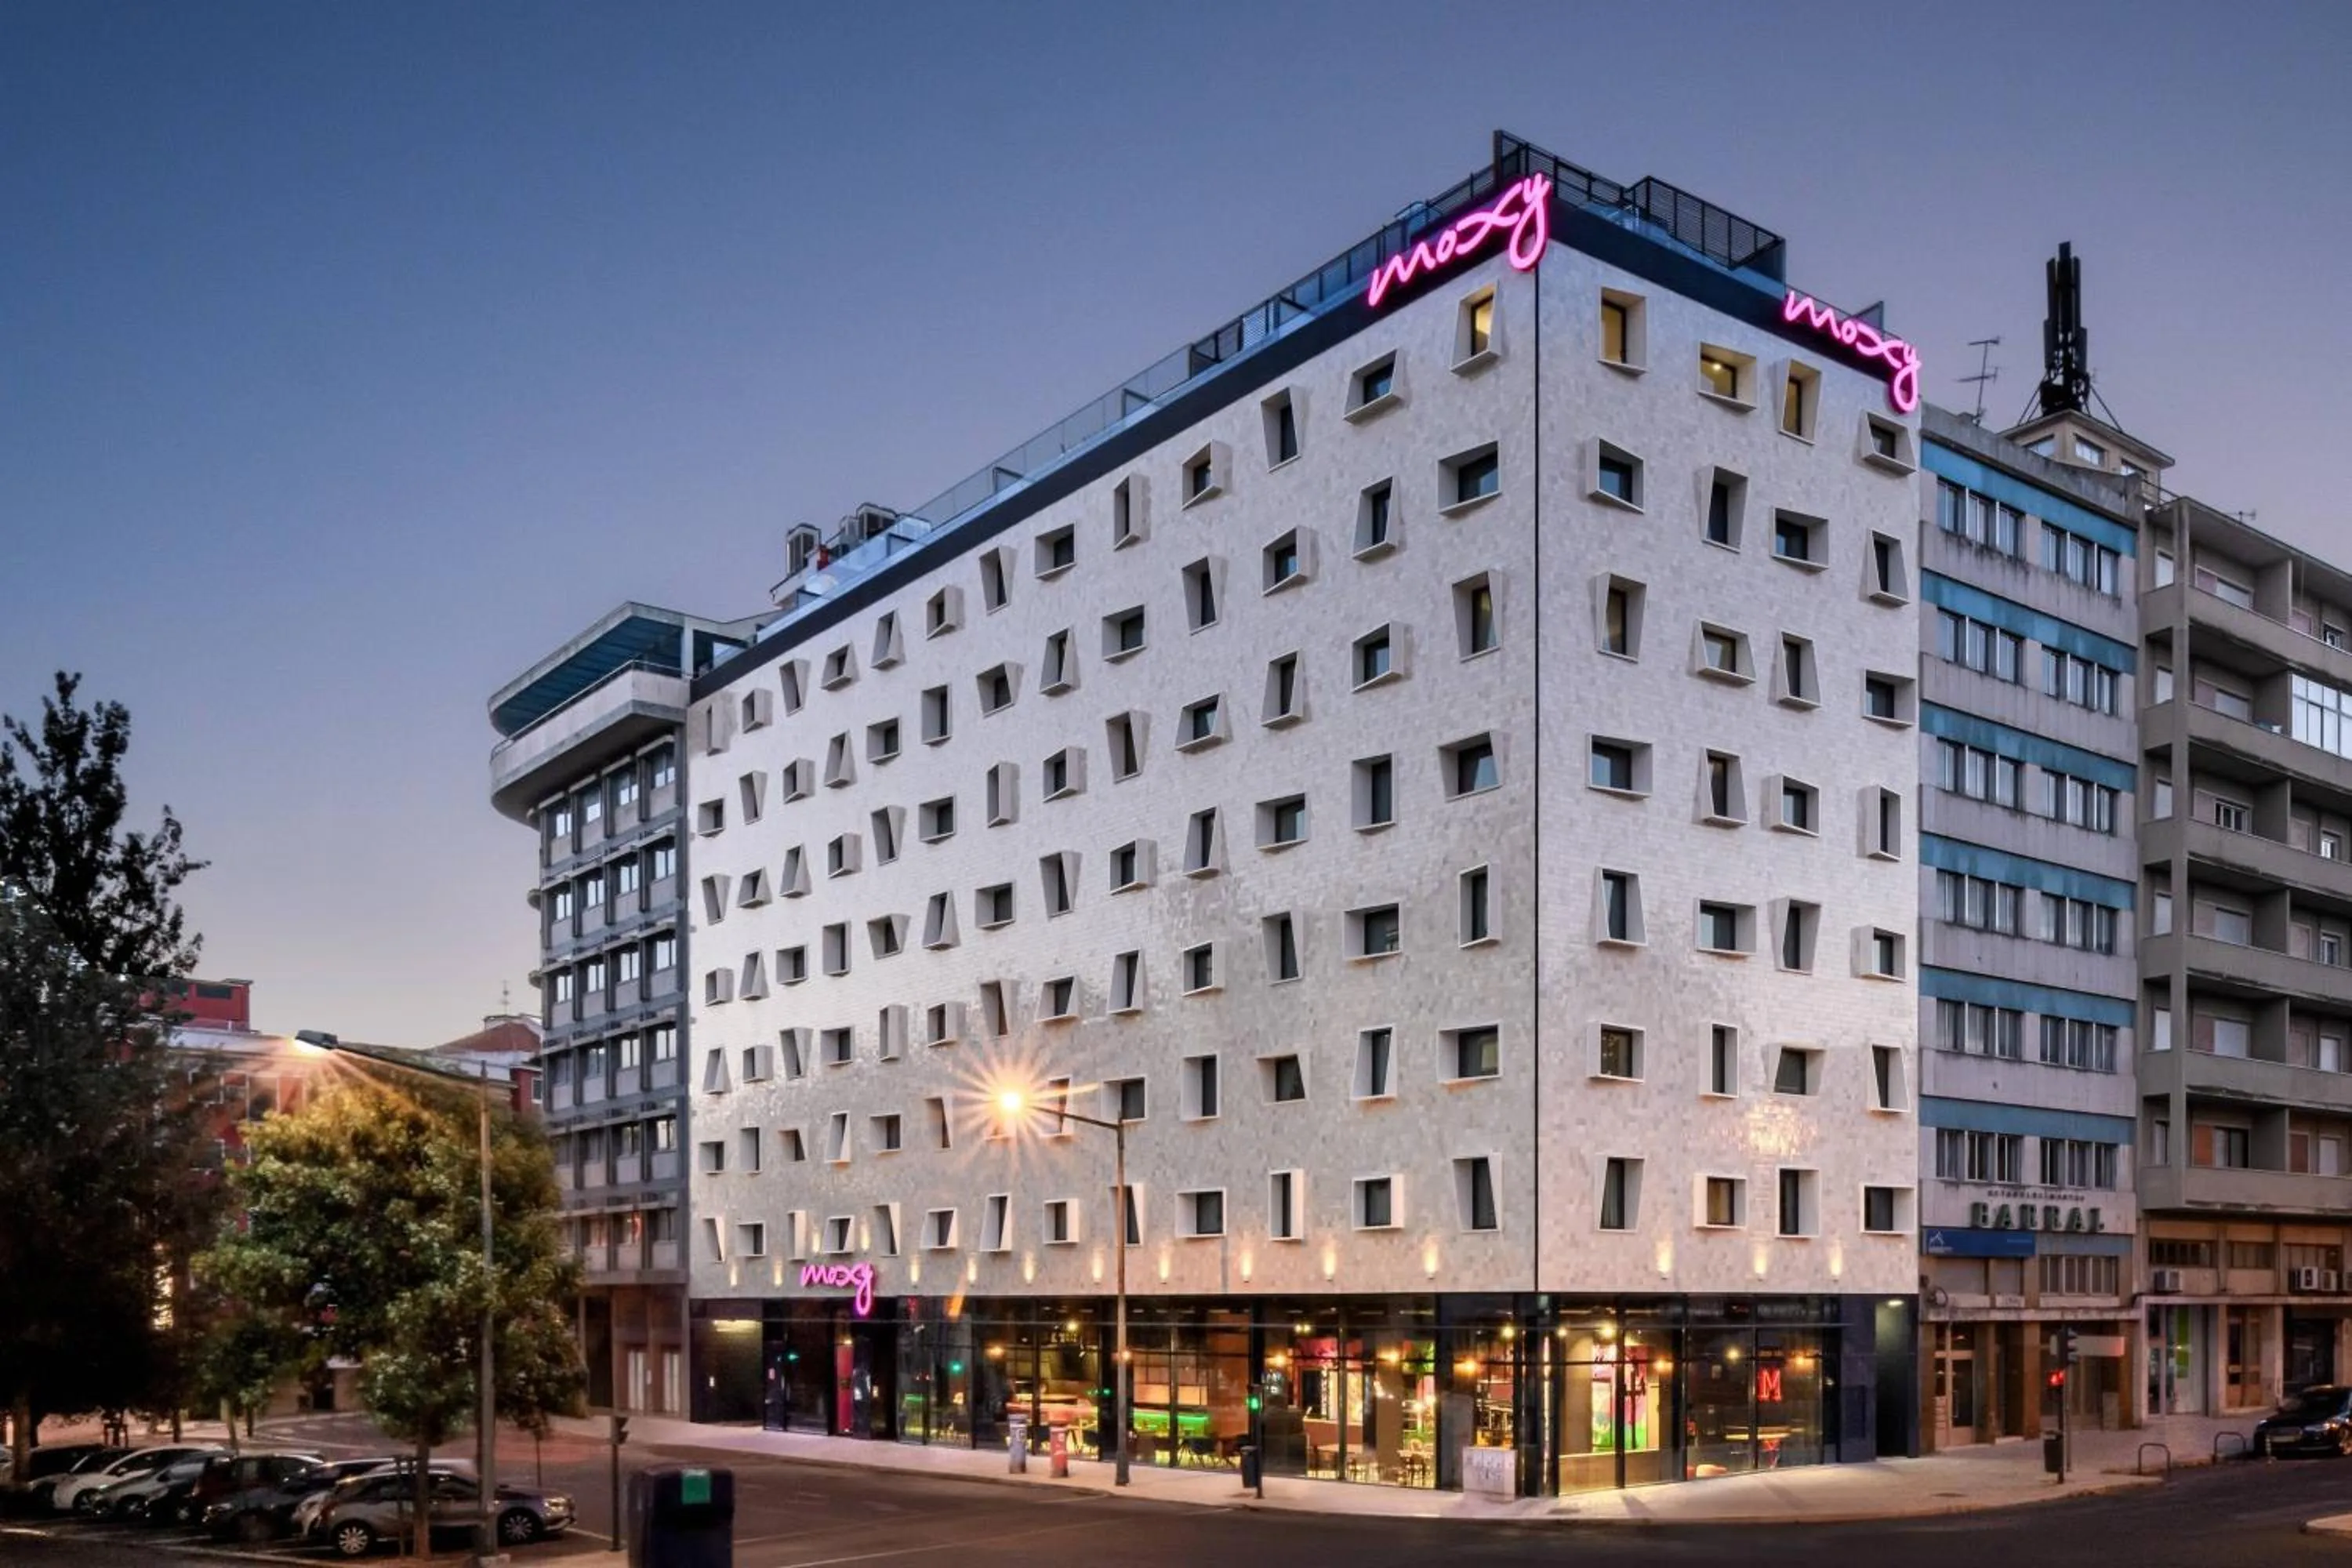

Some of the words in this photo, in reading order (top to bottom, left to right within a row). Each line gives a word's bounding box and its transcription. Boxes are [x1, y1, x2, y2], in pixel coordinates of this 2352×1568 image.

[1368, 172, 1551, 306] moxy
[1784, 291, 1922, 412] moxy
[800, 1262, 873, 1316] moxy
